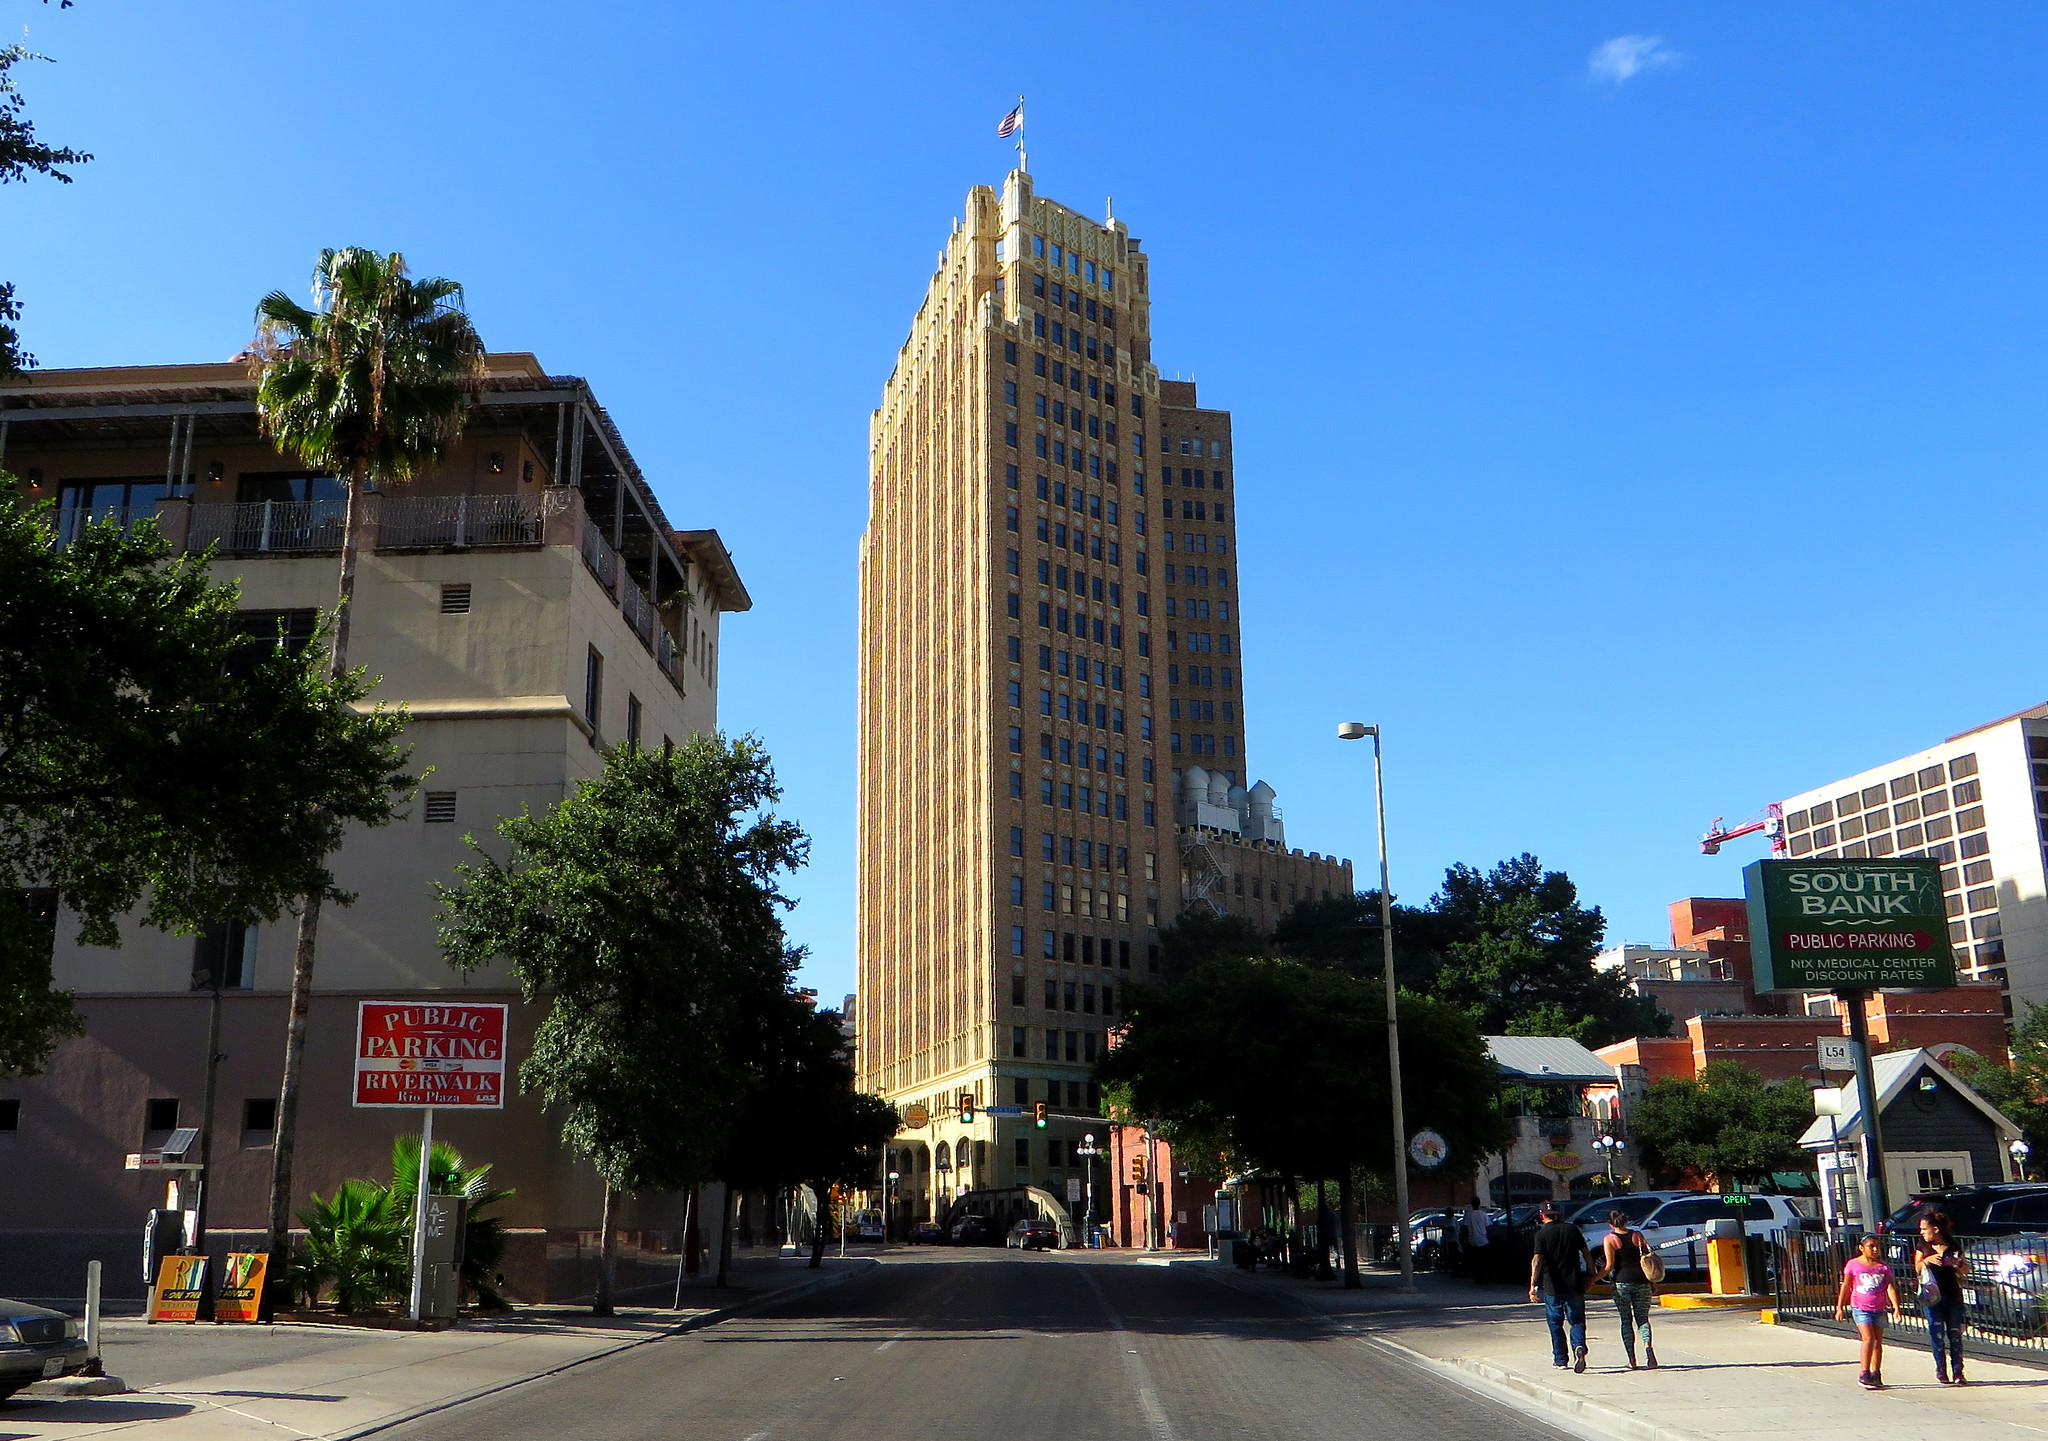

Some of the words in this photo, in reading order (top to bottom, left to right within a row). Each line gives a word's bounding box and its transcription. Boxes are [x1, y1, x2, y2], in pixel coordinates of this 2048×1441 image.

[1788, 872, 1917, 892] SOUTH
[1801, 895, 1911, 915] BANK
[1790, 933, 1845, 949] PUBLIC
[1849, 933, 1917, 949] PARKING
[1791, 959, 1814, 969] NIX
[1817, 958, 1880, 969] MEDICAL
[1883, 958, 1936, 968] CENTER
[1806, 970, 1876, 981] DISCOUNT
[1881, 970, 1924, 980] RATES
[383, 1008, 485, 1033] PUBLIC
[365, 1036, 498, 1059] PARKING
[1825, 1046, 1845, 1058] L54
[365, 1073, 493, 1091] RIVERWALK
[397, 1091, 421, 1102] Rio
[426, 1091, 460, 1103] Plaza
[1723, 1195, 1747, 1205] OPEN
